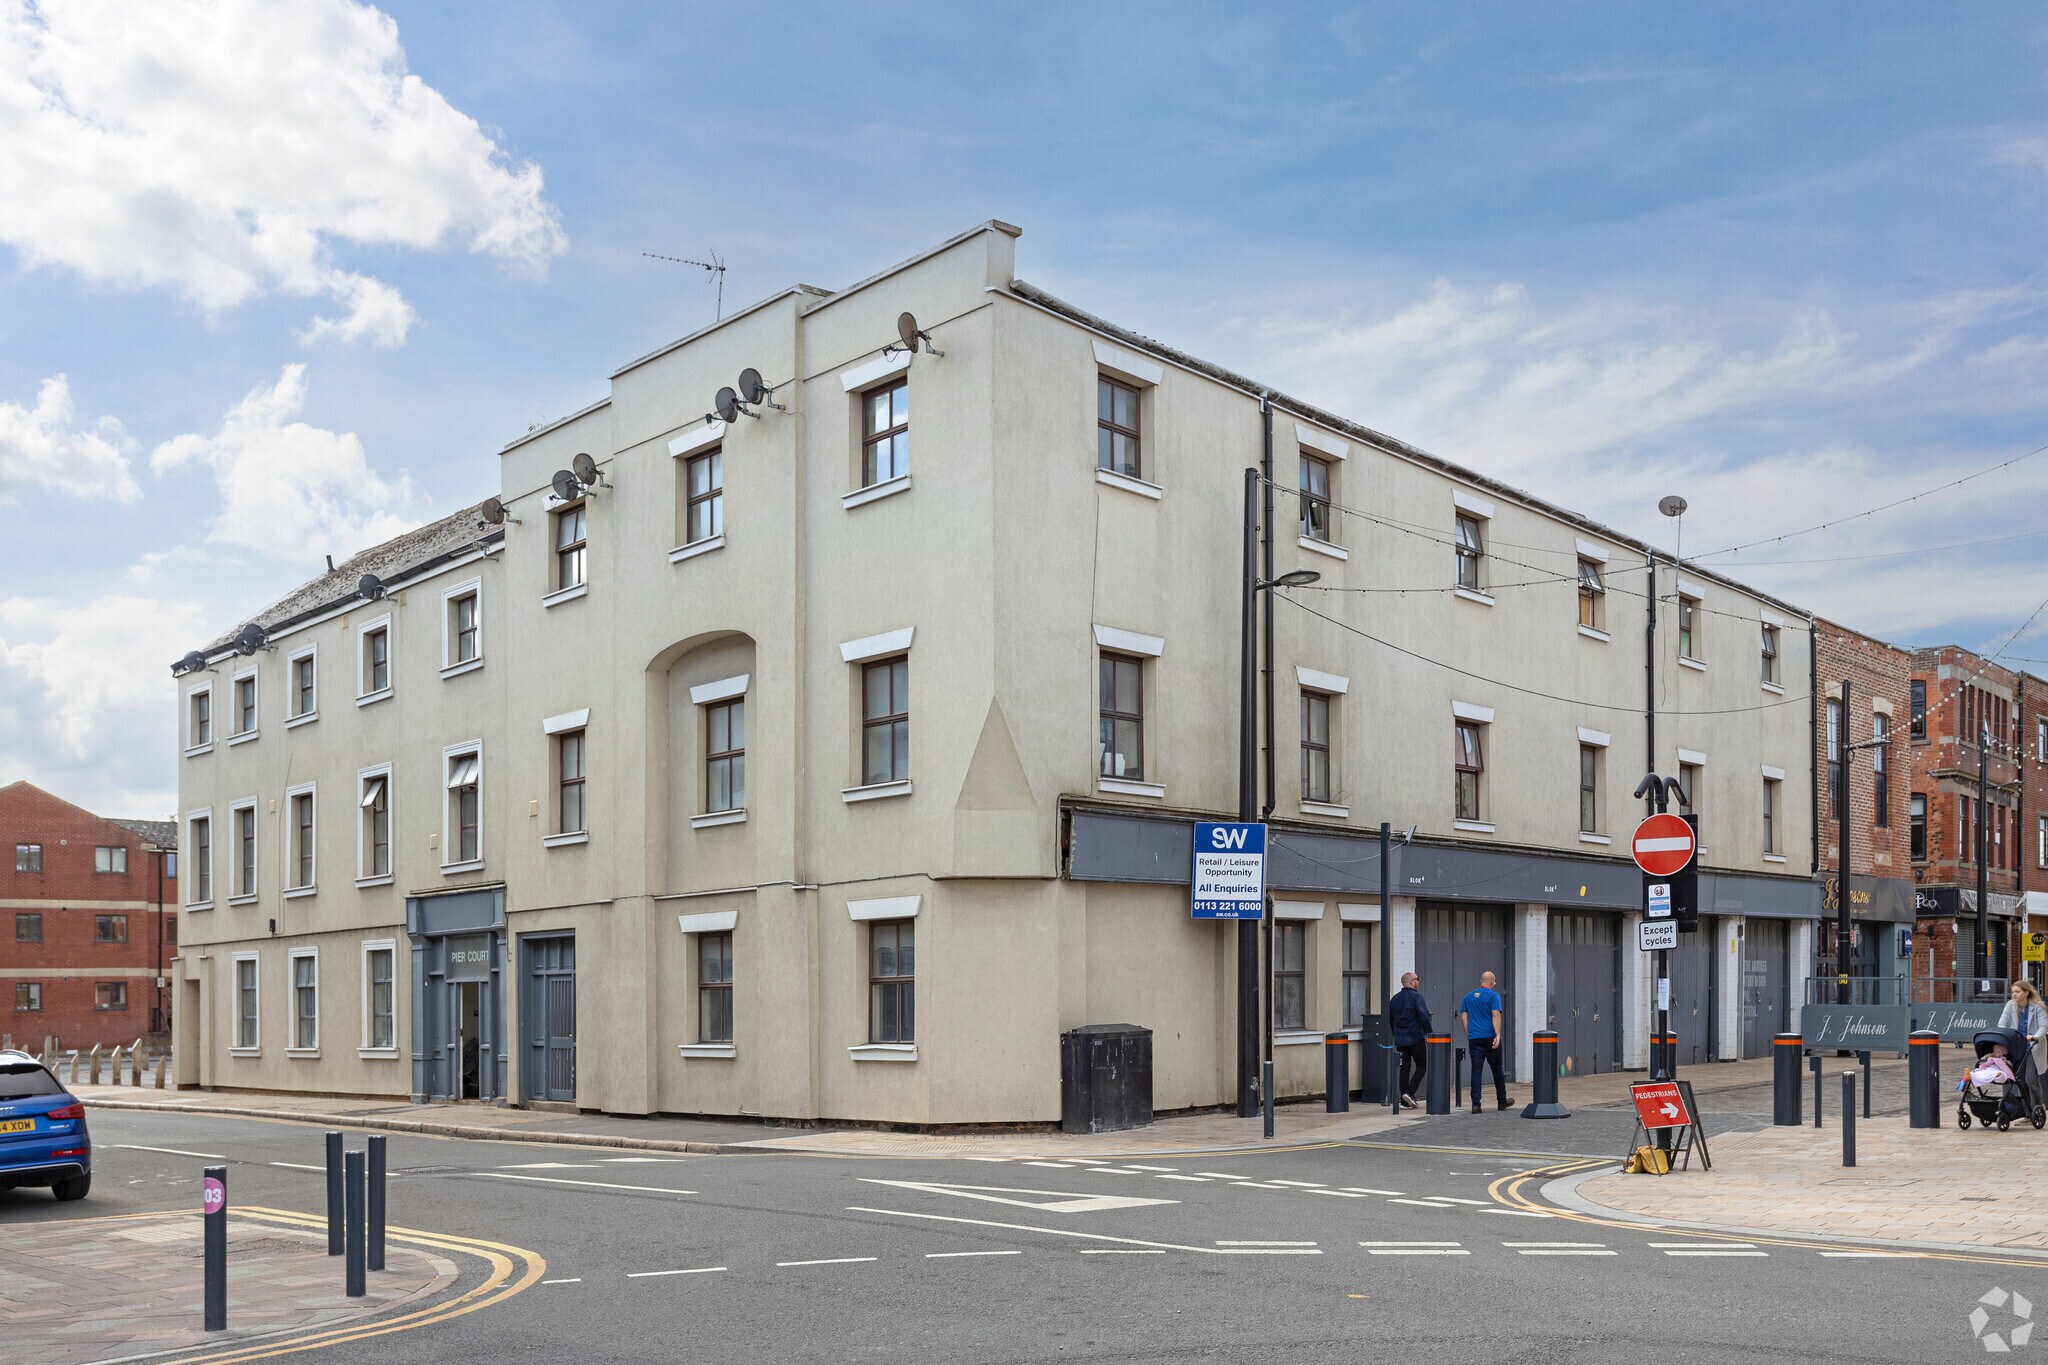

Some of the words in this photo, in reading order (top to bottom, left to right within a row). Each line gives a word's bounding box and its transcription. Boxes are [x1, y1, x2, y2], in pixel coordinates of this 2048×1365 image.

[1212, 827, 1248, 849] SW
[1205, 868, 1252, 877] Opportunity
[1199, 884, 1212, 892] All
[1214, 884, 1258, 894] Enquiries
[1194, 901, 1217, 910] 0113
[1219, 902, 1236, 910] 221
[1238, 902, 1262, 911] 6000
[1644, 925, 1673, 935] Except
[1645, 936, 1672, 946] cycles
[452, 952, 466, 962] PIER
[468, 950, 488, 962] COURT
[1943, 1011, 1989, 1034] Johnsons
[1816, 1014, 1832, 1042] J.
[1838, 1015, 1888, 1042] Johnsons
[1635, 1090, 1677, 1100] PEDESTRIANS
